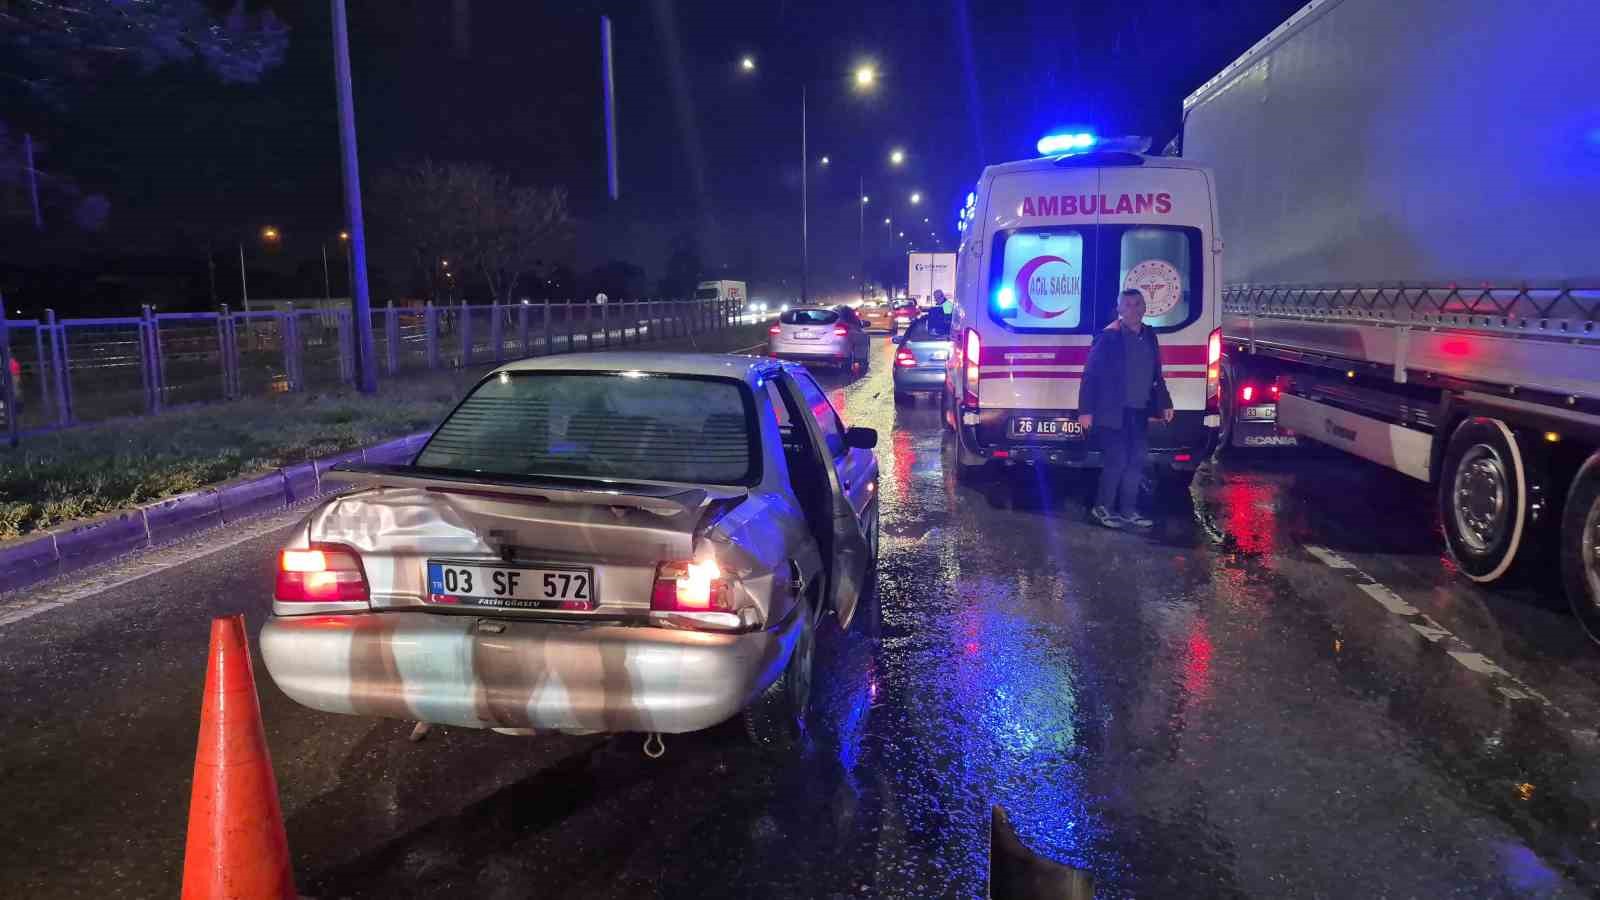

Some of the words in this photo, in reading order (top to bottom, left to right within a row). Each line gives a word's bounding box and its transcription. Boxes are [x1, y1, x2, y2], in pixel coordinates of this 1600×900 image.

[1022, 193, 1172, 217] AMBULANS
[1019, 420, 1032, 433] 26
[1037, 421, 1056, 433] AEG
[1062, 421, 1080, 433] 405
[1245, 436, 1297, 446] SCANIA
[444, 568, 473, 593] 03
[492, 571, 520, 596] SF
[543, 574, 587, 599] 572
